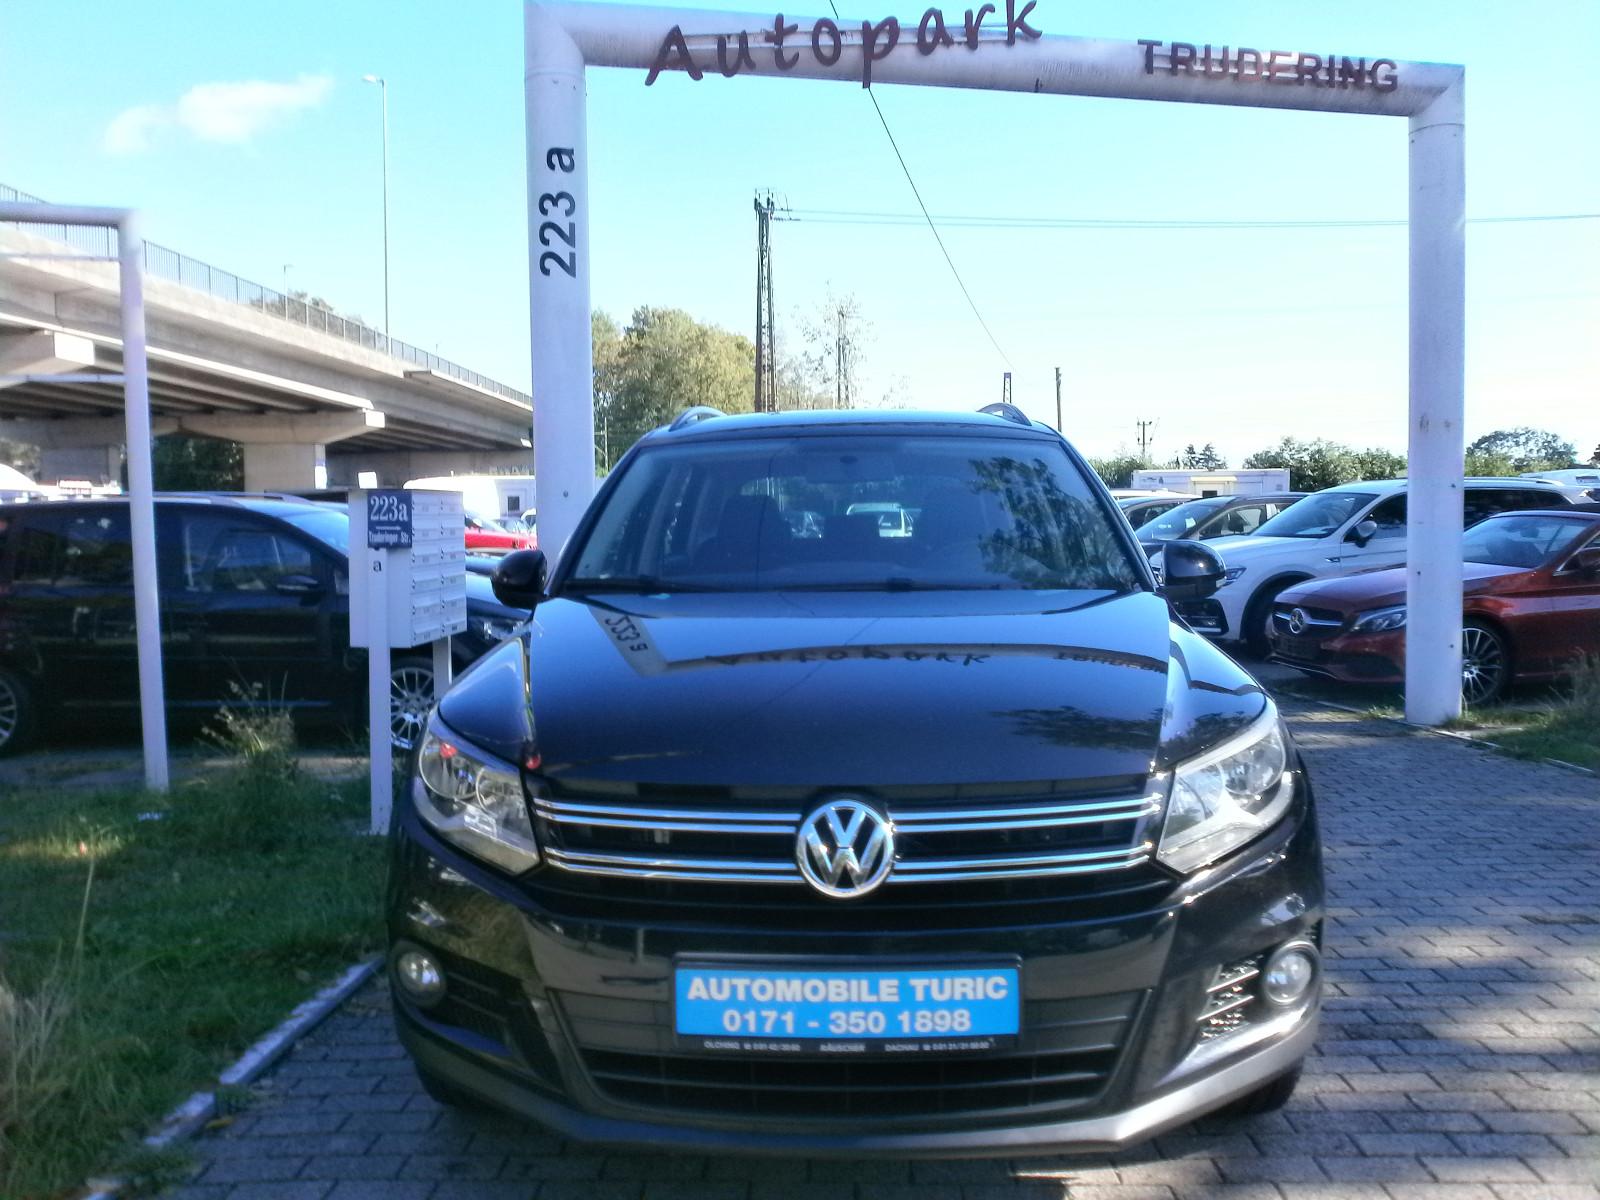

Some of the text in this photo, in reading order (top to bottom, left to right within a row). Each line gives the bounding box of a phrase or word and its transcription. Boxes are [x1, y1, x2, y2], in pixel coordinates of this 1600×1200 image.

[644, 0, 1043, 89] Autopark
[1137, 38, 1399, 93] TRUDERING
[538, 146, 577, 279] 223 a
[370, 495, 409, 522] 223a
[373, 560, 382, 572] a
[798, 799, 894, 897] VW
[686, 976, 1009, 1003] AUTOMOBILE TURIC
[722, 1009, 796, 1034] 0171
[828, 1010, 887, 1034] 350
[897, 1008, 972, 1033] 1898
